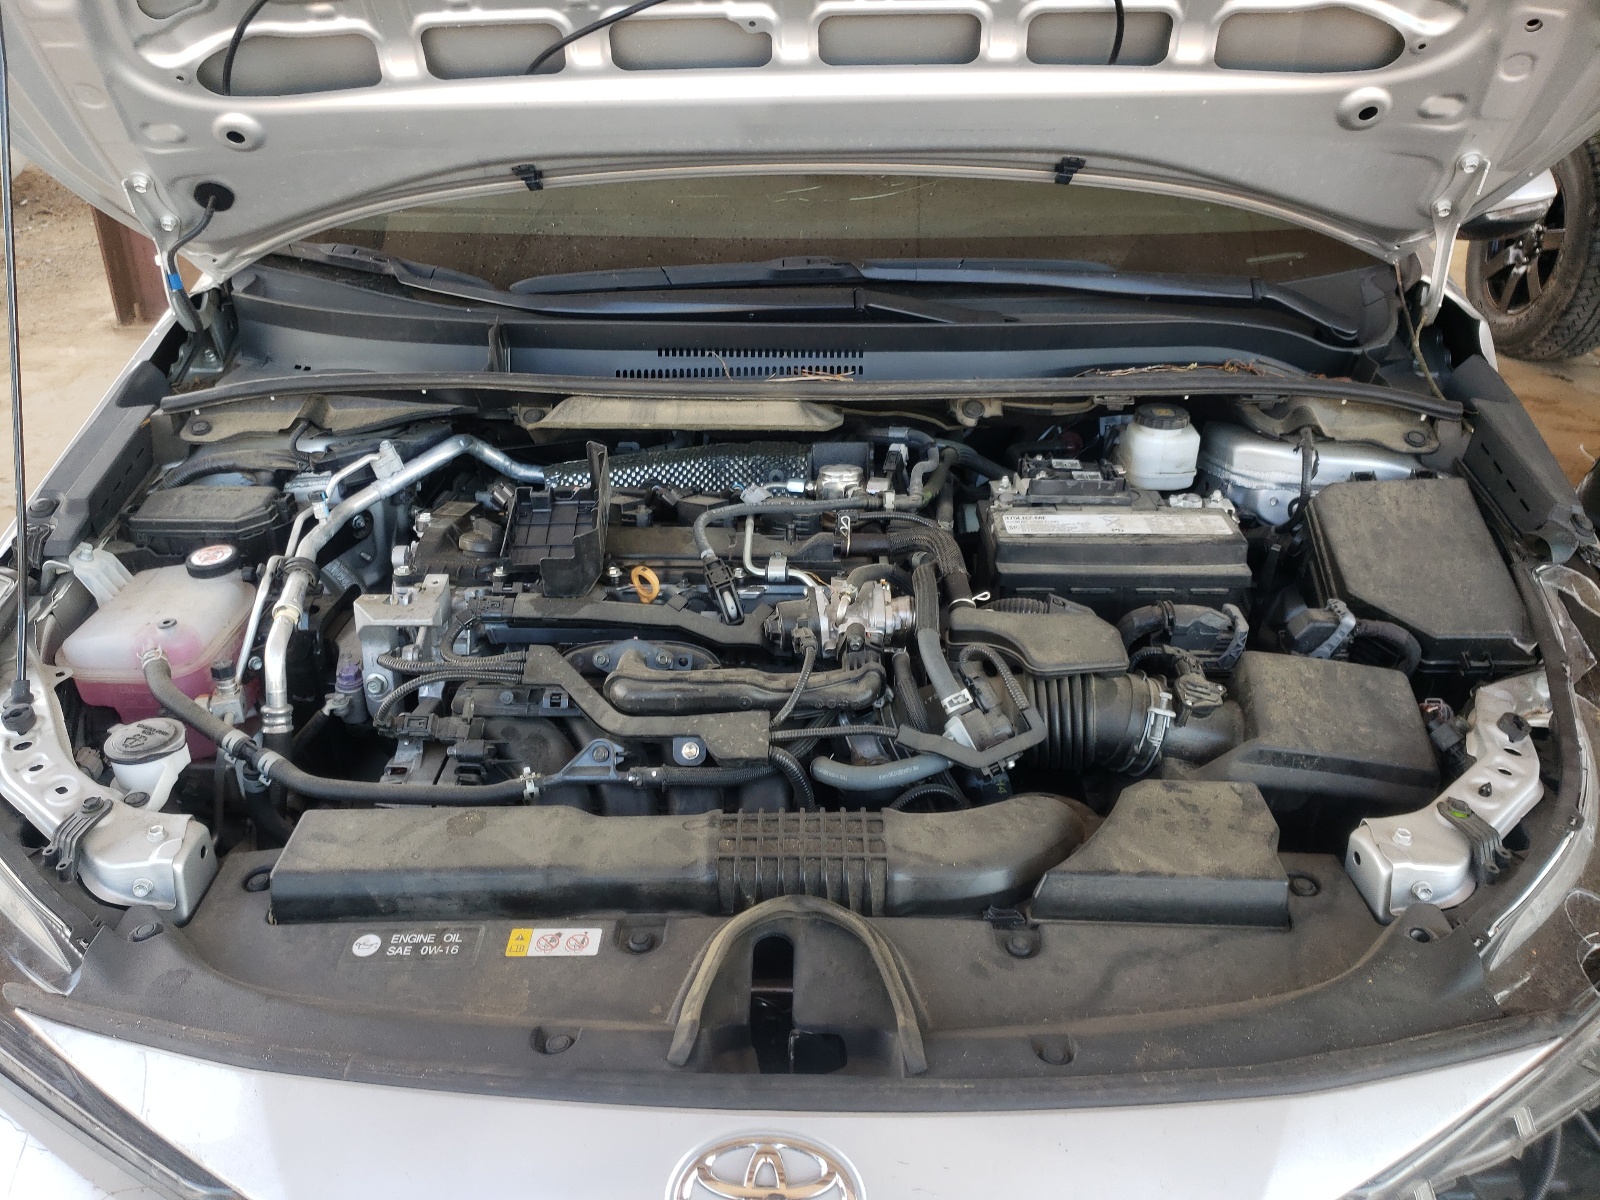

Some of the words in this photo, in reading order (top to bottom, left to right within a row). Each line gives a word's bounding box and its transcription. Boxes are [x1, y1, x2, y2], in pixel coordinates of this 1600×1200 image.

[390, 934, 436, 944] ENGINE
[443, 933, 462, 943] OIL
[386, 945, 413, 956] SAE
[420, 945, 459, 955] 0W-16
